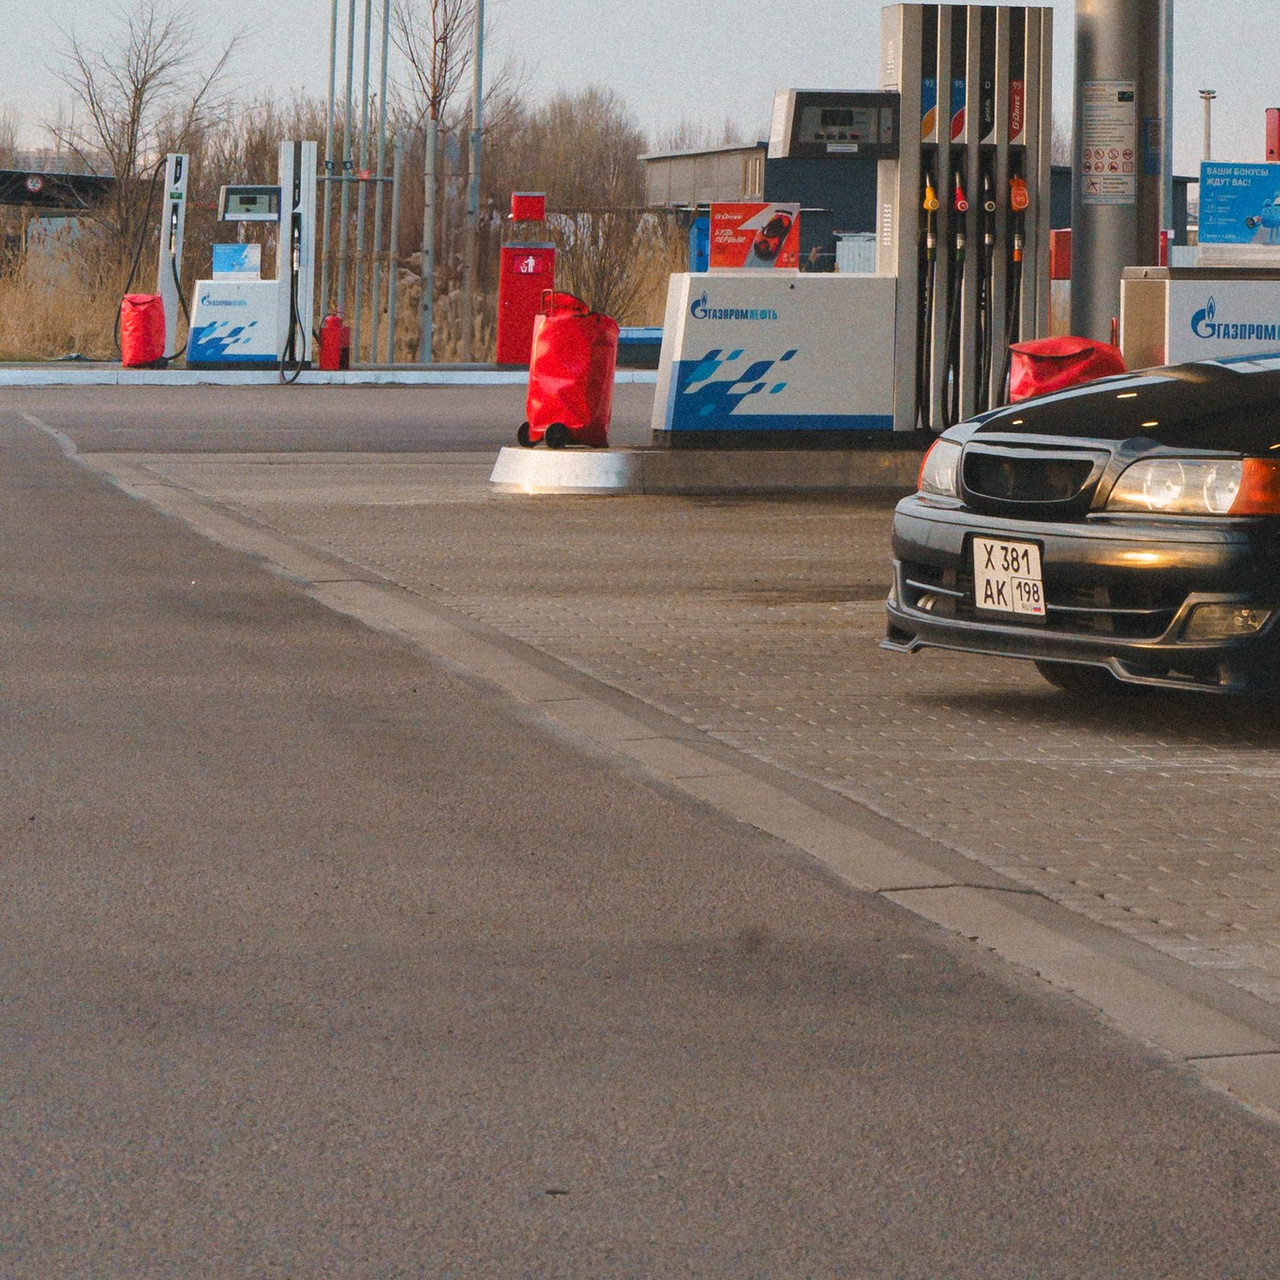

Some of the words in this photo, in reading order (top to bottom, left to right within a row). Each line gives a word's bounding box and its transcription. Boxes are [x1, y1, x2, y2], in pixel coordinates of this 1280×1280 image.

[924, 79, 935, 88] 92
[954, 80, 964, 89] 95
[1012, 81, 1022, 90] 95
[1206, 167, 1233, 175] ВАШИ
[1233, 167, 1269, 177] БОНУСЫ
[1206, 177, 1231, 186] ЖДУТ
[1231, 178, 1252, 187] ВАС!
[707, 308, 778, 320] ГАЗПРОМНЕФТЬ
[1000, 545, 1030, 575] 381
[1015, 580, 1040, 603] 198
